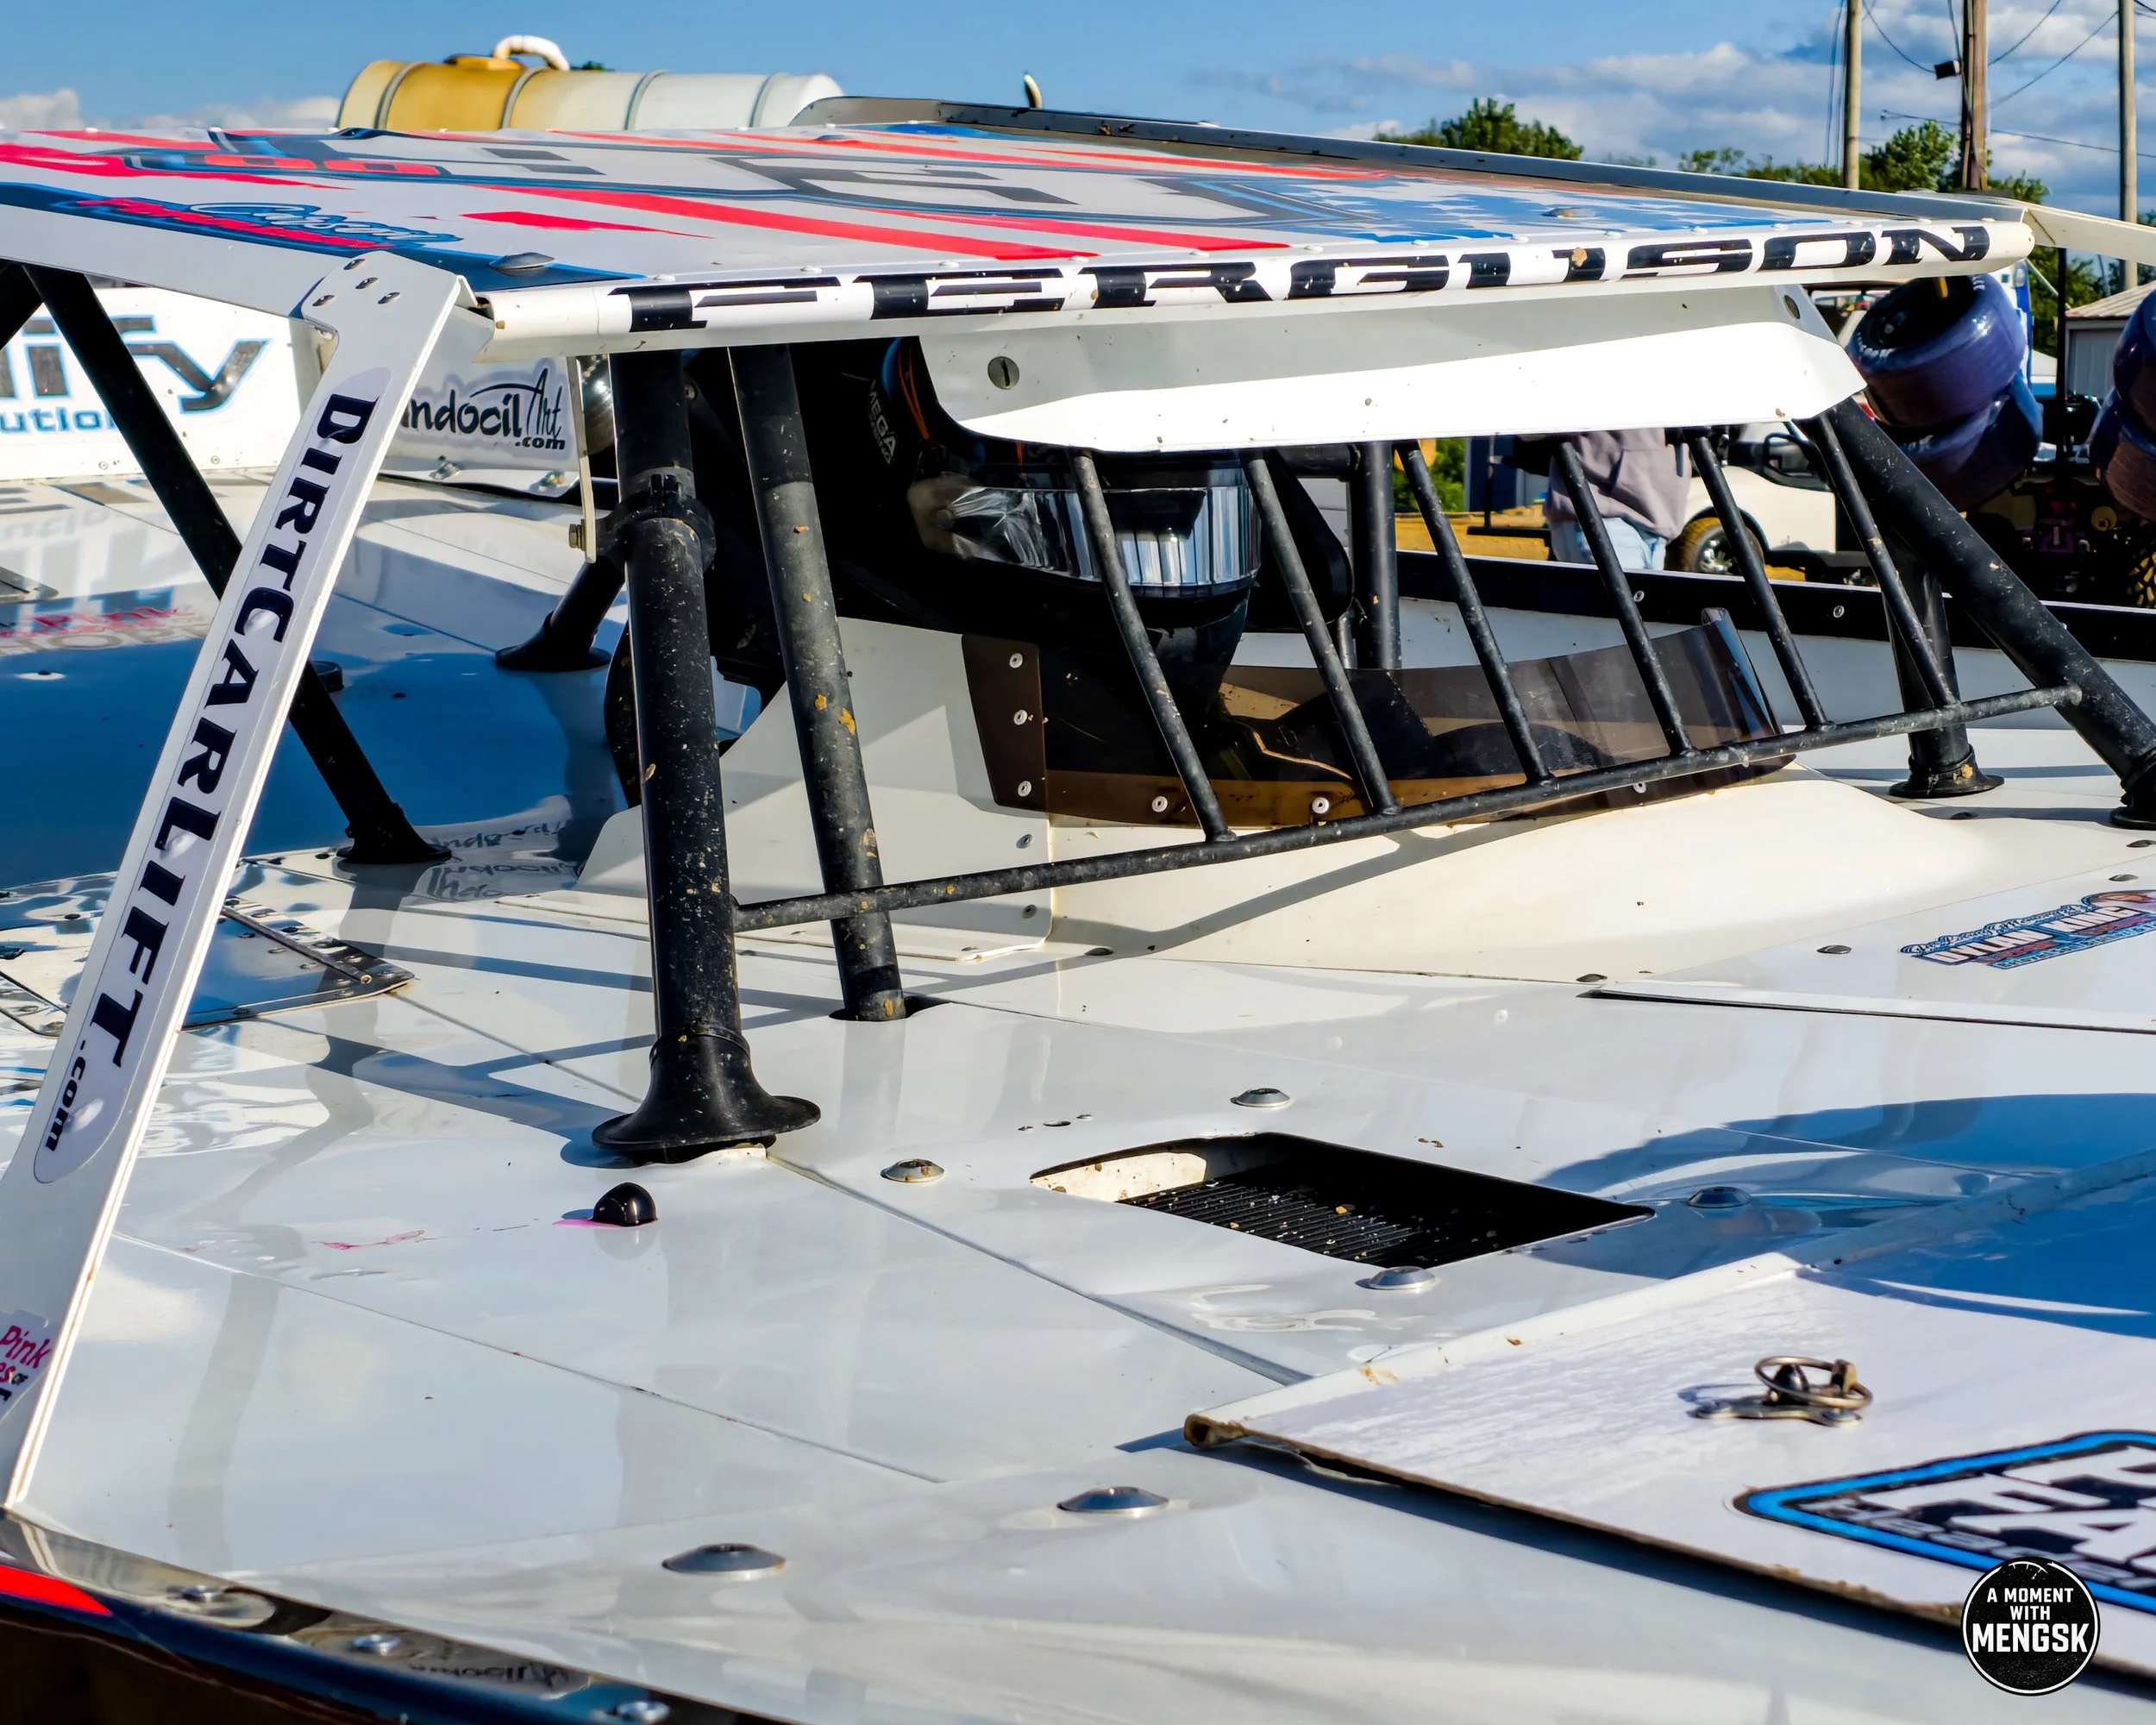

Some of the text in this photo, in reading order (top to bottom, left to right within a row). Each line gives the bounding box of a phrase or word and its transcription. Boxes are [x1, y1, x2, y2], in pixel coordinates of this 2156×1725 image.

[607, 226, 1990, 333] FERGUSON
[515, 436, 566, 449] .com
[2039, 906, 2144, 933] KING
[0, 1325, 52, 1369] Pink
